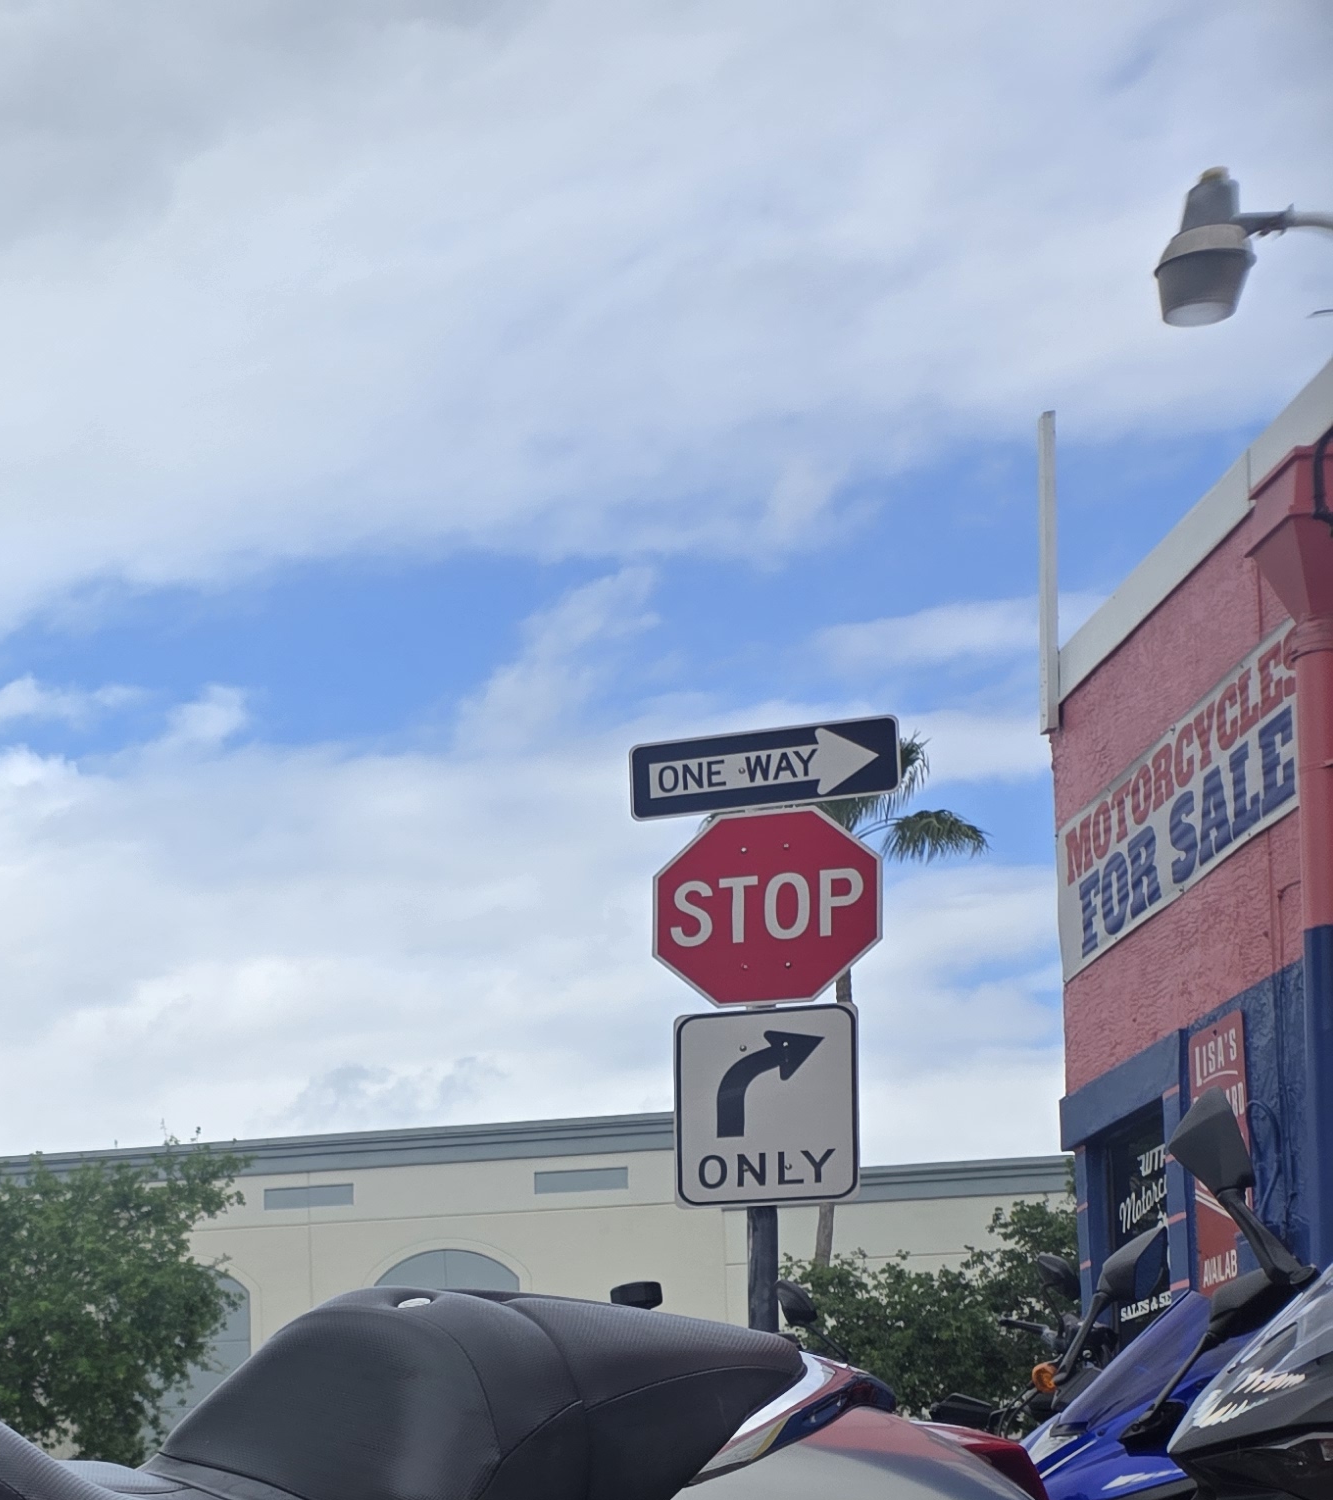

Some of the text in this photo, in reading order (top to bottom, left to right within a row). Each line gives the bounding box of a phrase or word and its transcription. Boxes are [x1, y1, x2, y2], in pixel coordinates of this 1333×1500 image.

[658, 748, 818, 793] ONE WAY
[1079, 704, 1297, 959] FOR SALE
[670, 867, 864, 948] STOP
[1194, 1028, 1237, 1087] LISA'S
[698, 1148, 836, 1189] ONLY
[1120, 1299, 1150, 1322] SALES
